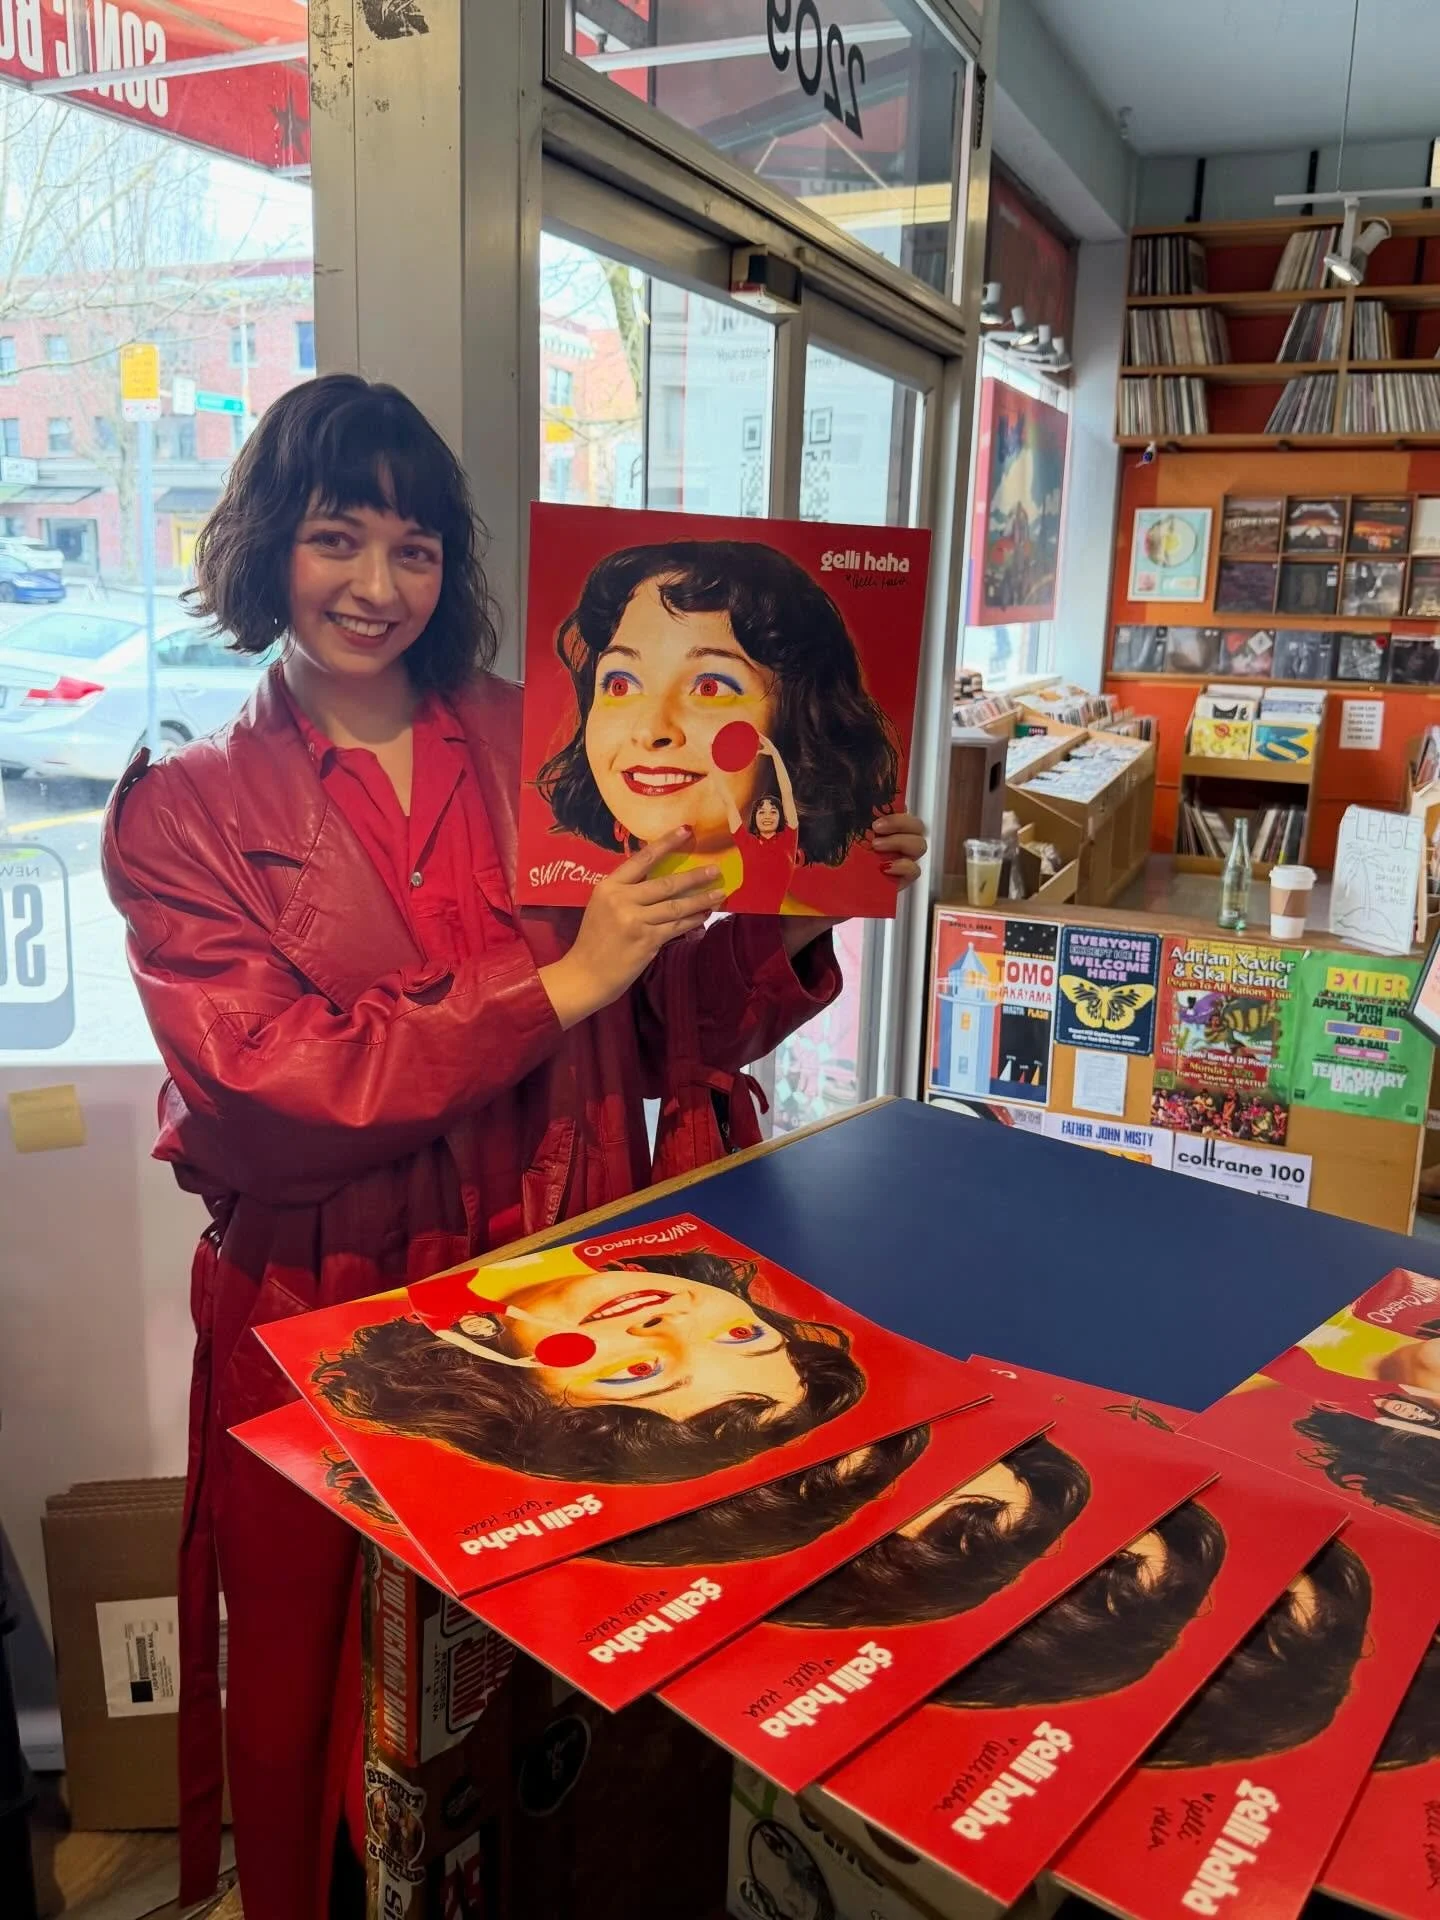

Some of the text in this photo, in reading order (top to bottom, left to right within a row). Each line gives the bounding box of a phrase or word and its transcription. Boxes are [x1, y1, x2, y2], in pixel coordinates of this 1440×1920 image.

[821, 550, 910, 573] gelli haha
[1070, 934, 1151, 952] EVERYONE
[1069, 955, 1150, 974] WELCOME
[1135, 951, 1150, 963] IS
[1170, 946, 1295, 973] Adrian Xavier
[996, 960, 1054, 987] TOMO
[1086, 968, 1128, 982] HERE
[1173, 962, 1288, 989] & Ska Island
[1312, 998, 1351, 1012] APPLES
[1355, 1004, 1383, 1017] WITH
[1189, 1061, 1227, 1076] Monday
[1312, 1061, 1407, 1089] TEMPORARY
[1061, 1119, 1093, 1138] FATHER
[1095, 1125, 1121, 1142] JOHN
[1123, 1130, 1154, 1147] MISTY
[1178, 1137, 1263, 1177] coltrane
[1269, 1163, 1305, 1184] 100
[583, 1221, 698, 1257] SWITCHEROO
[459, 1493, 604, 1556] gelli haha
[588, 1576, 722, 1664] gelli haha
[759, 1640, 893, 1739] gelli haha
[951, 1720, 1074, 1841] gelli haha
[1181, 1778, 1281, 1916] gelli haha
